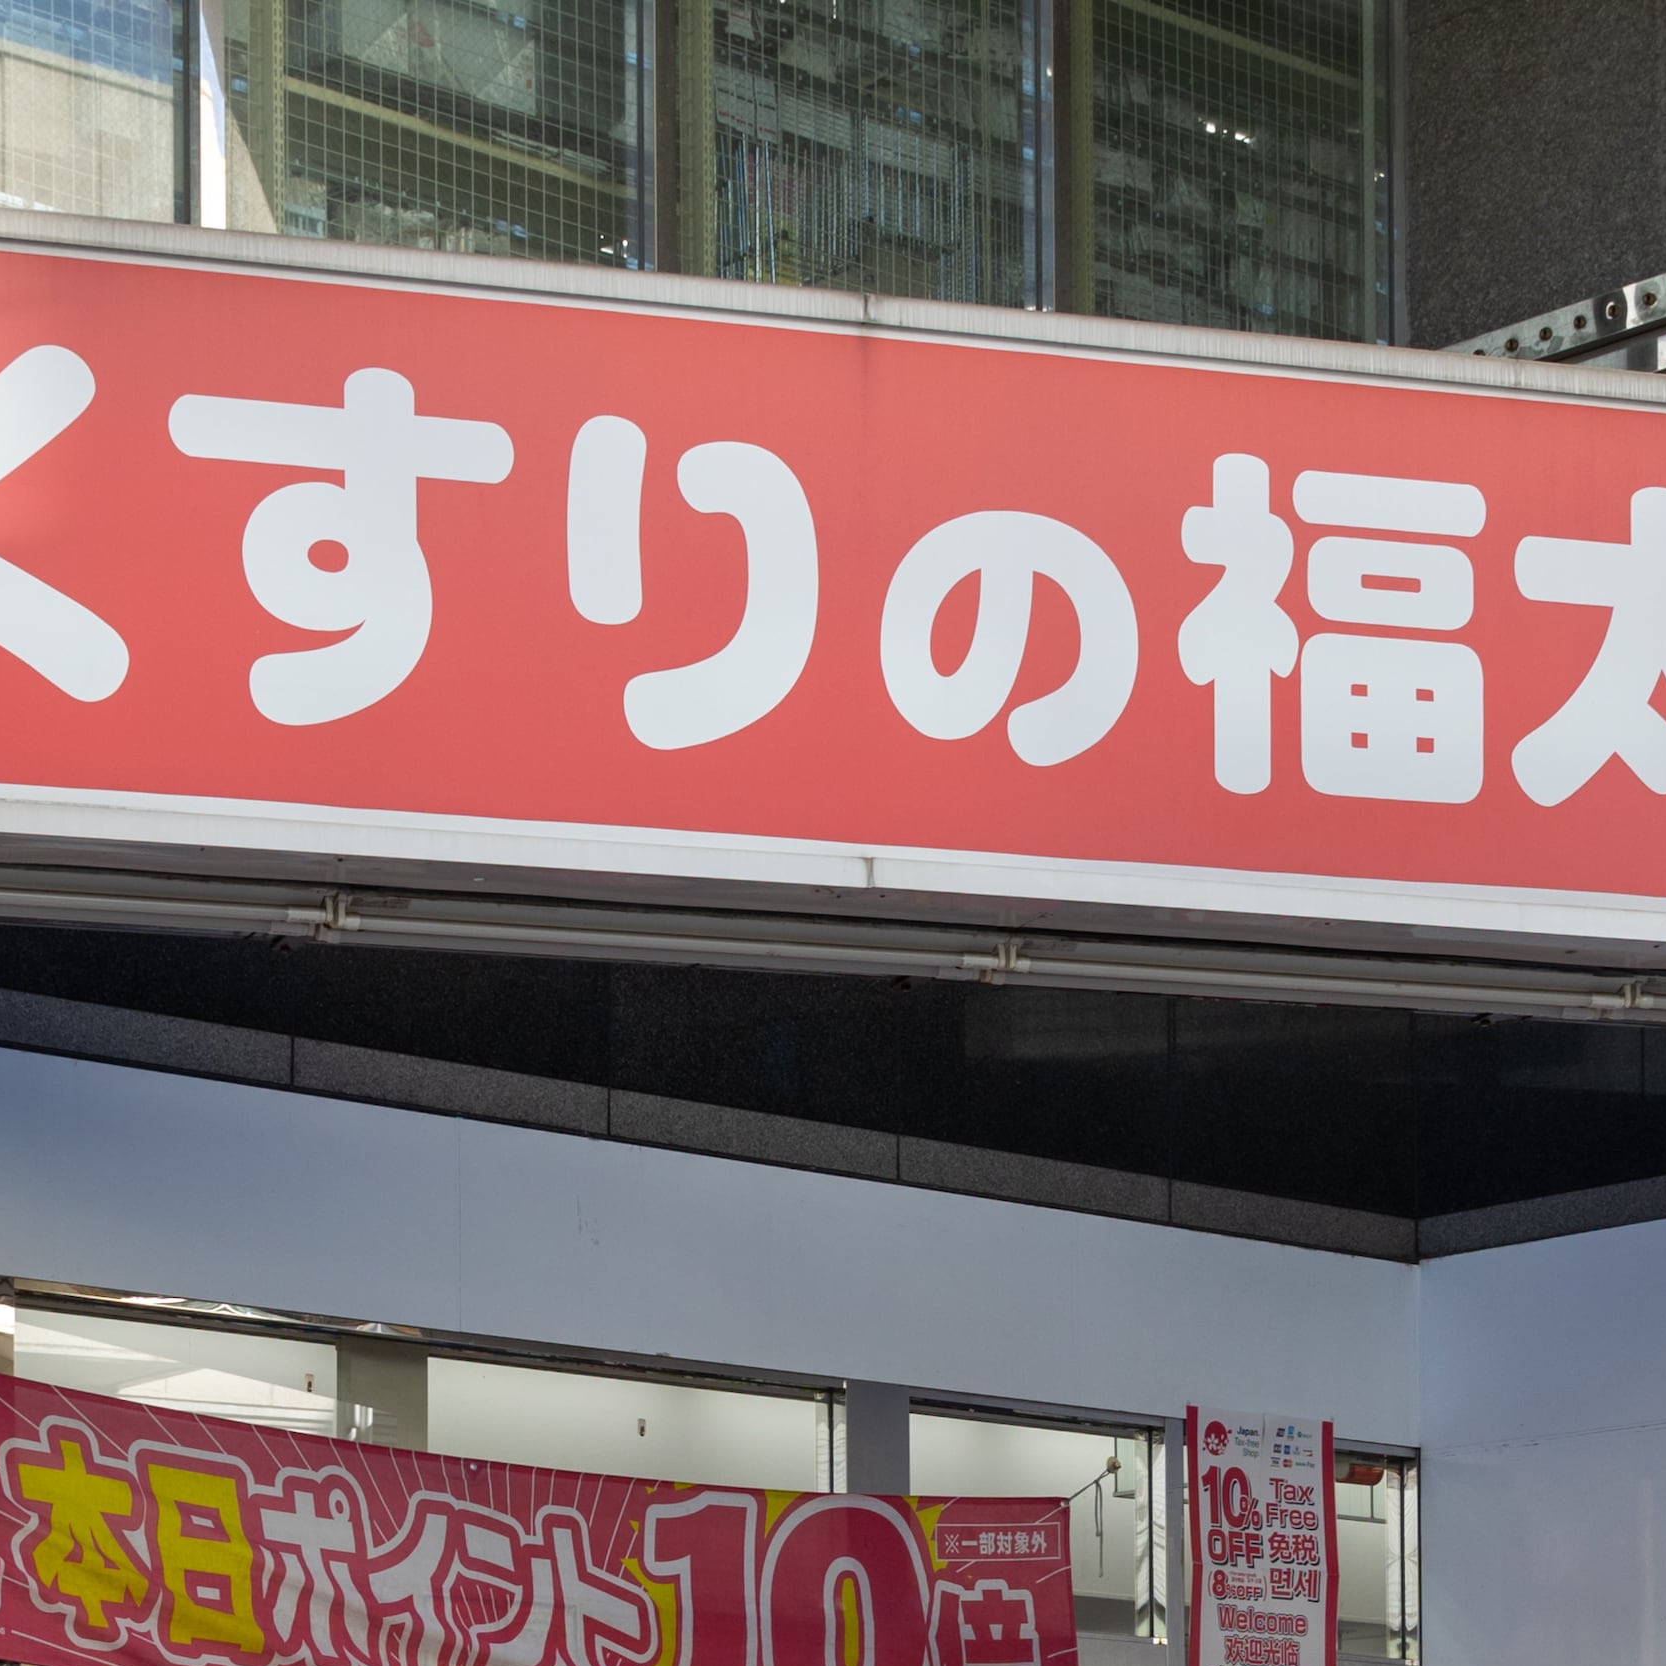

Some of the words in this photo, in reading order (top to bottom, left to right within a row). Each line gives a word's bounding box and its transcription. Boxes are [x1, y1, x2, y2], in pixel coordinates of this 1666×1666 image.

[1201, 1465, 1262, 1529] 10%
[1269, 1477, 1314, 1507] Tax
[1265, 1502, 1319, 1530] Free
[1207, 1528, 1263, 1567] OFF
[1268, 1530, 1320, 1566] 免税
[1269, 1567, 1321, 1603] 면세
[1218, 1604, 1309, 1636] Welcome
